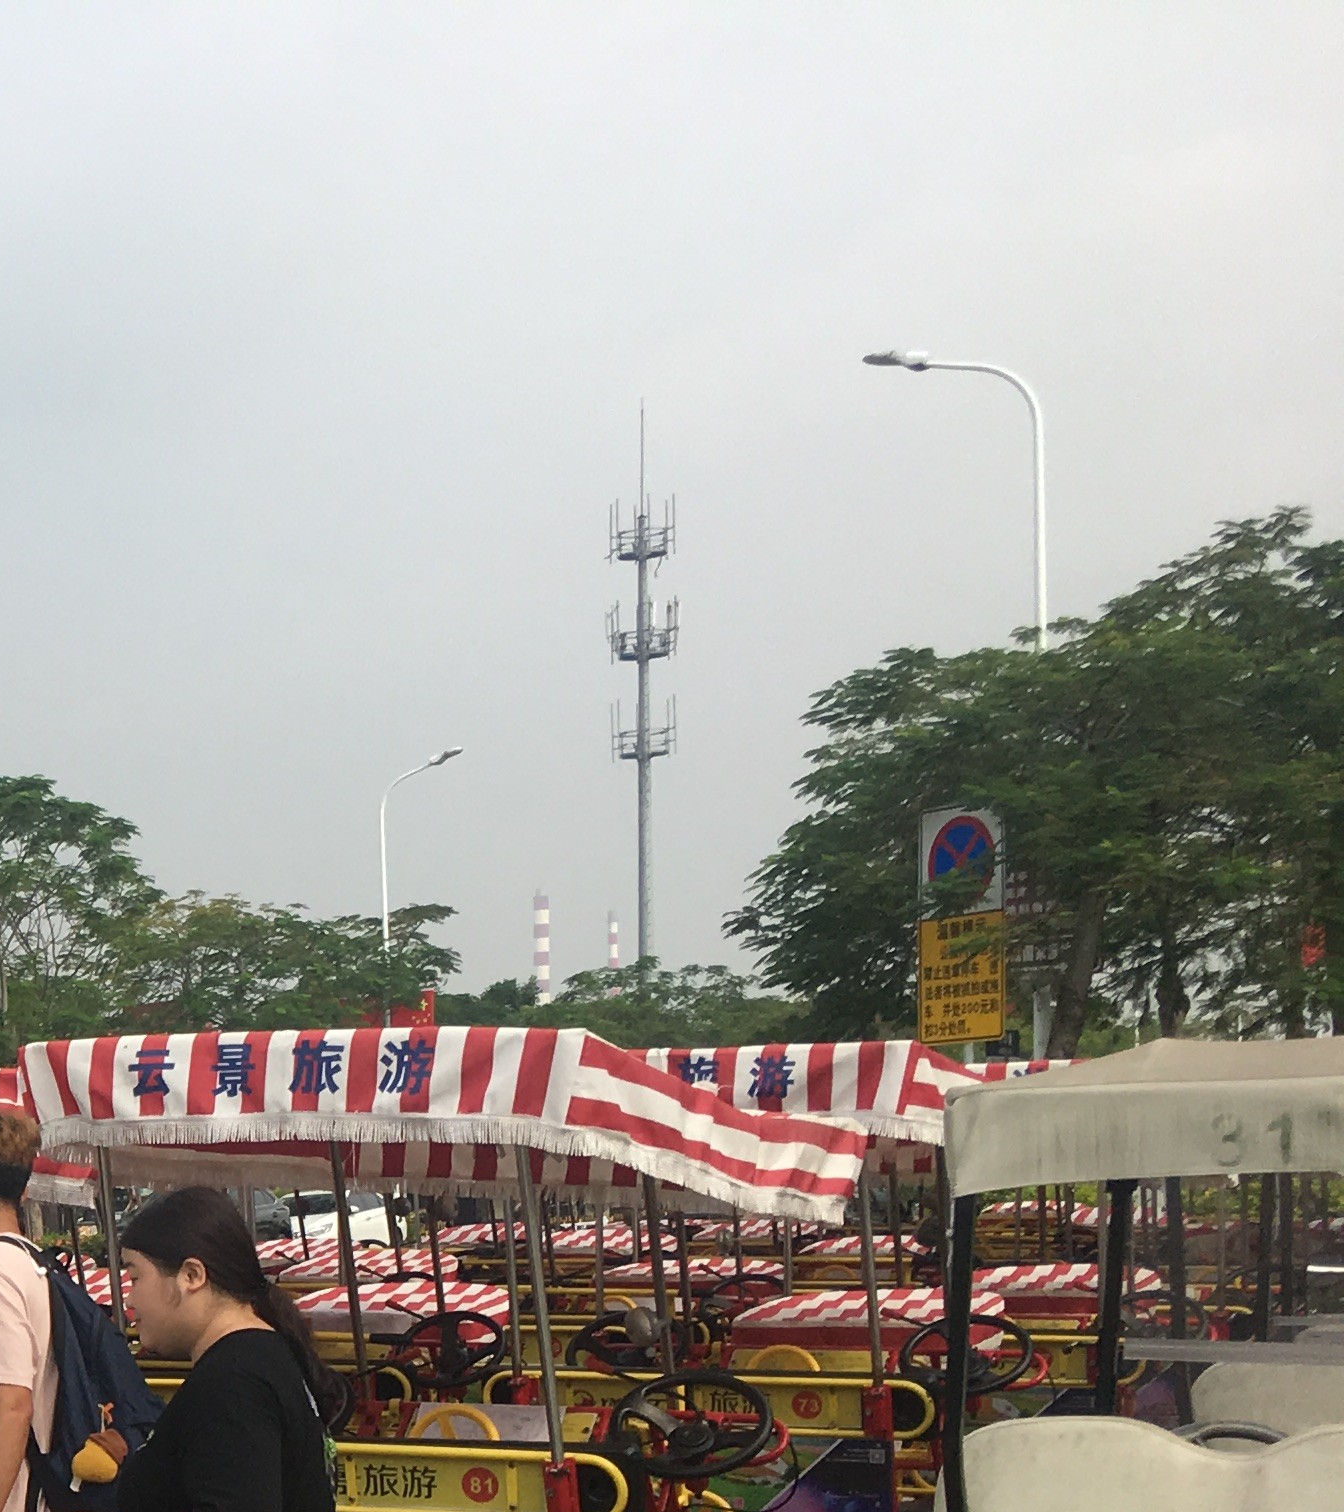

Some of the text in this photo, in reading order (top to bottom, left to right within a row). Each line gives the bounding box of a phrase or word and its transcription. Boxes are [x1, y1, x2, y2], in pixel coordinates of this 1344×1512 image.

[127, 1038, 436, 1098] 云景旅游
[798, 1398, 820, 1412] 73
[470, 1476, 494, 1495] 81
